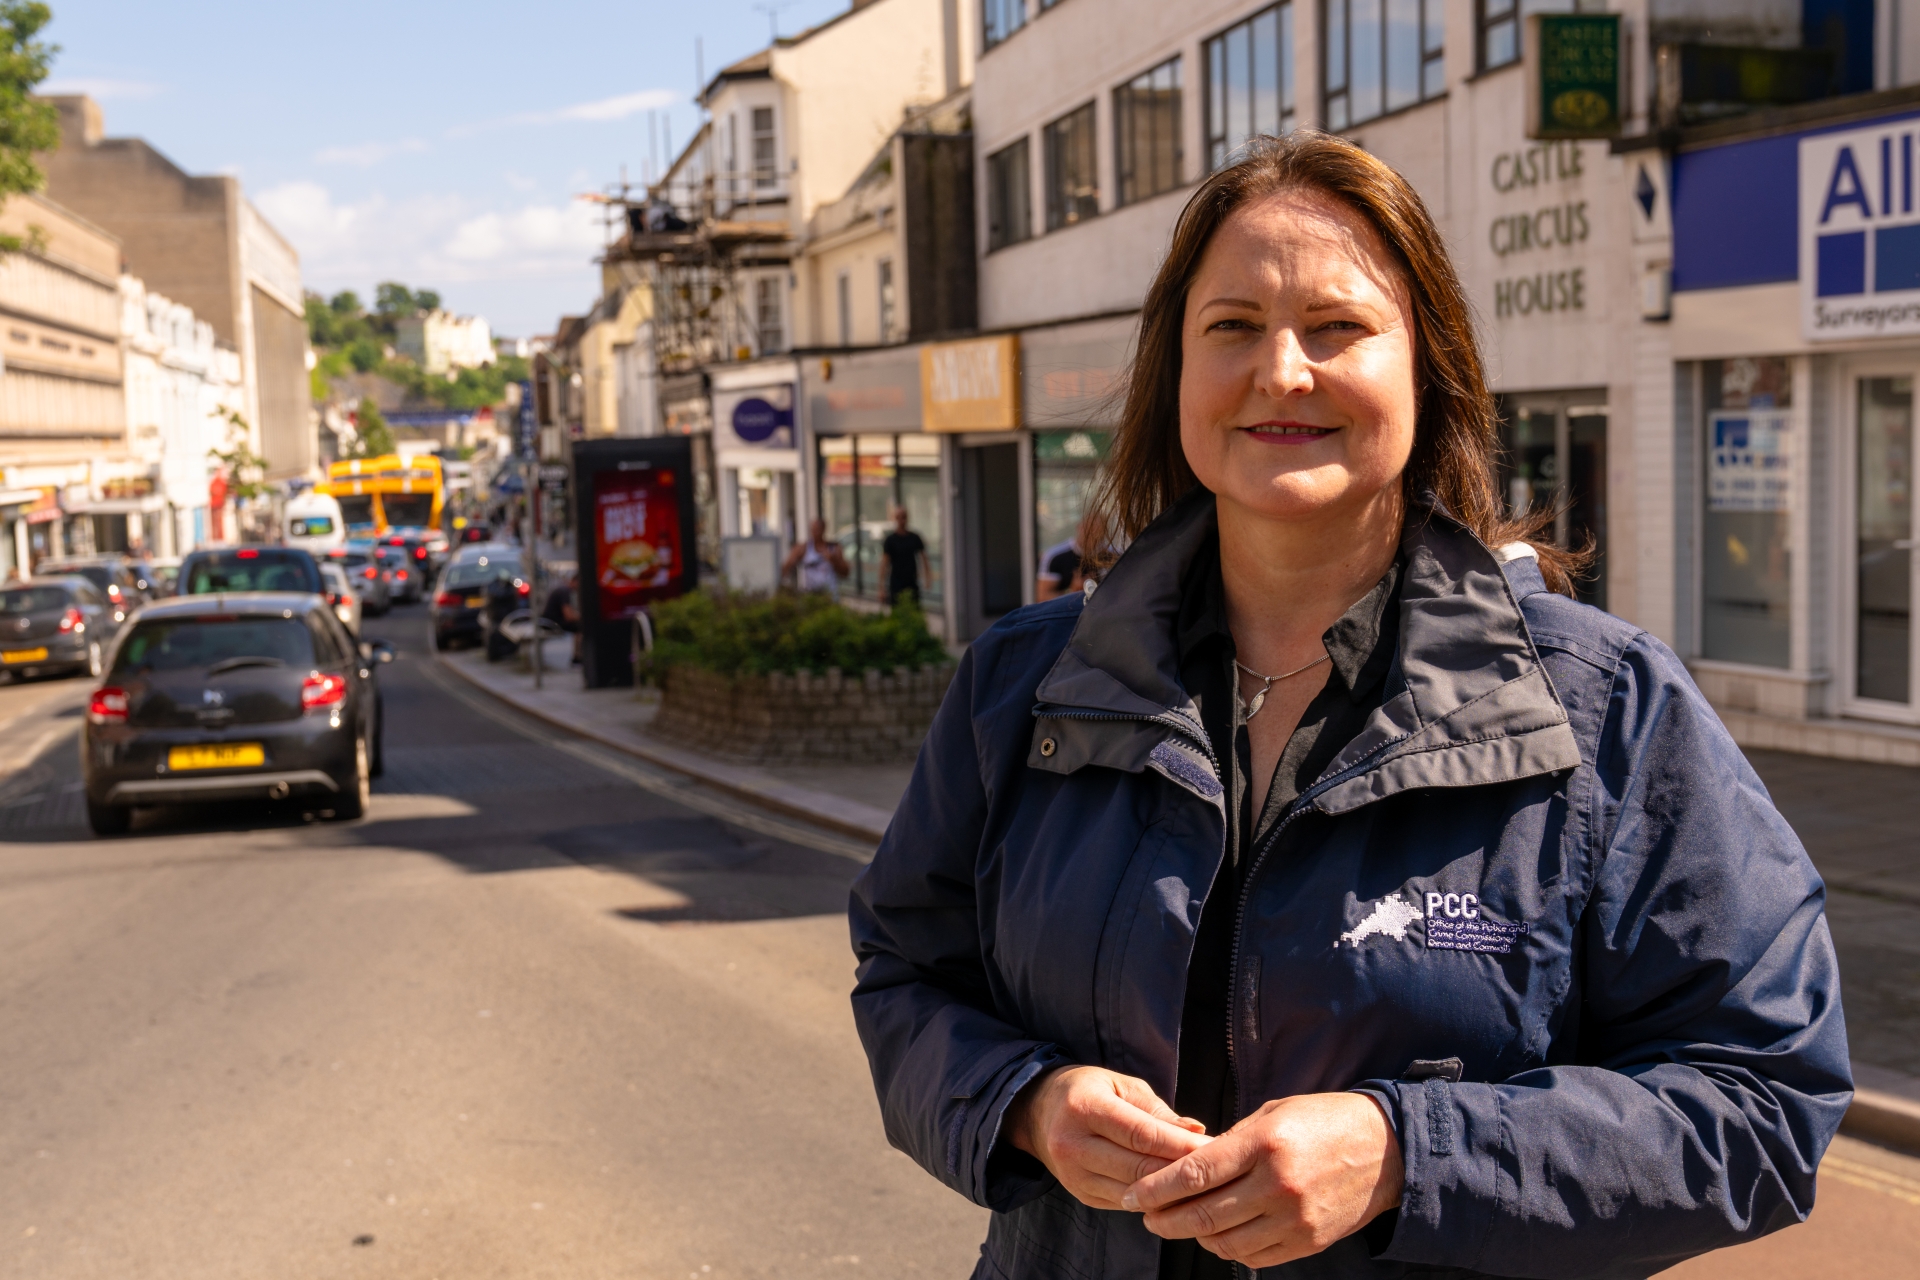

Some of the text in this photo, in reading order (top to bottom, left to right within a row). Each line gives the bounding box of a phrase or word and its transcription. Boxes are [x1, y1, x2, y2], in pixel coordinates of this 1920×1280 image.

[1491, 138, 1584, 194] CASTLE
[1490, 201, 1589, 259] CIRCUS
[1495, 267, 1584, 320] HOUSE
[1426, 892, 1478, 919] PCC
[1428, 919, 1526, 933] Office of the Police and
[1428, 929, 1454, 939] Crime
[1428, 938, 1454, 947] Devon
[1456, 941, 1471, 949] and
